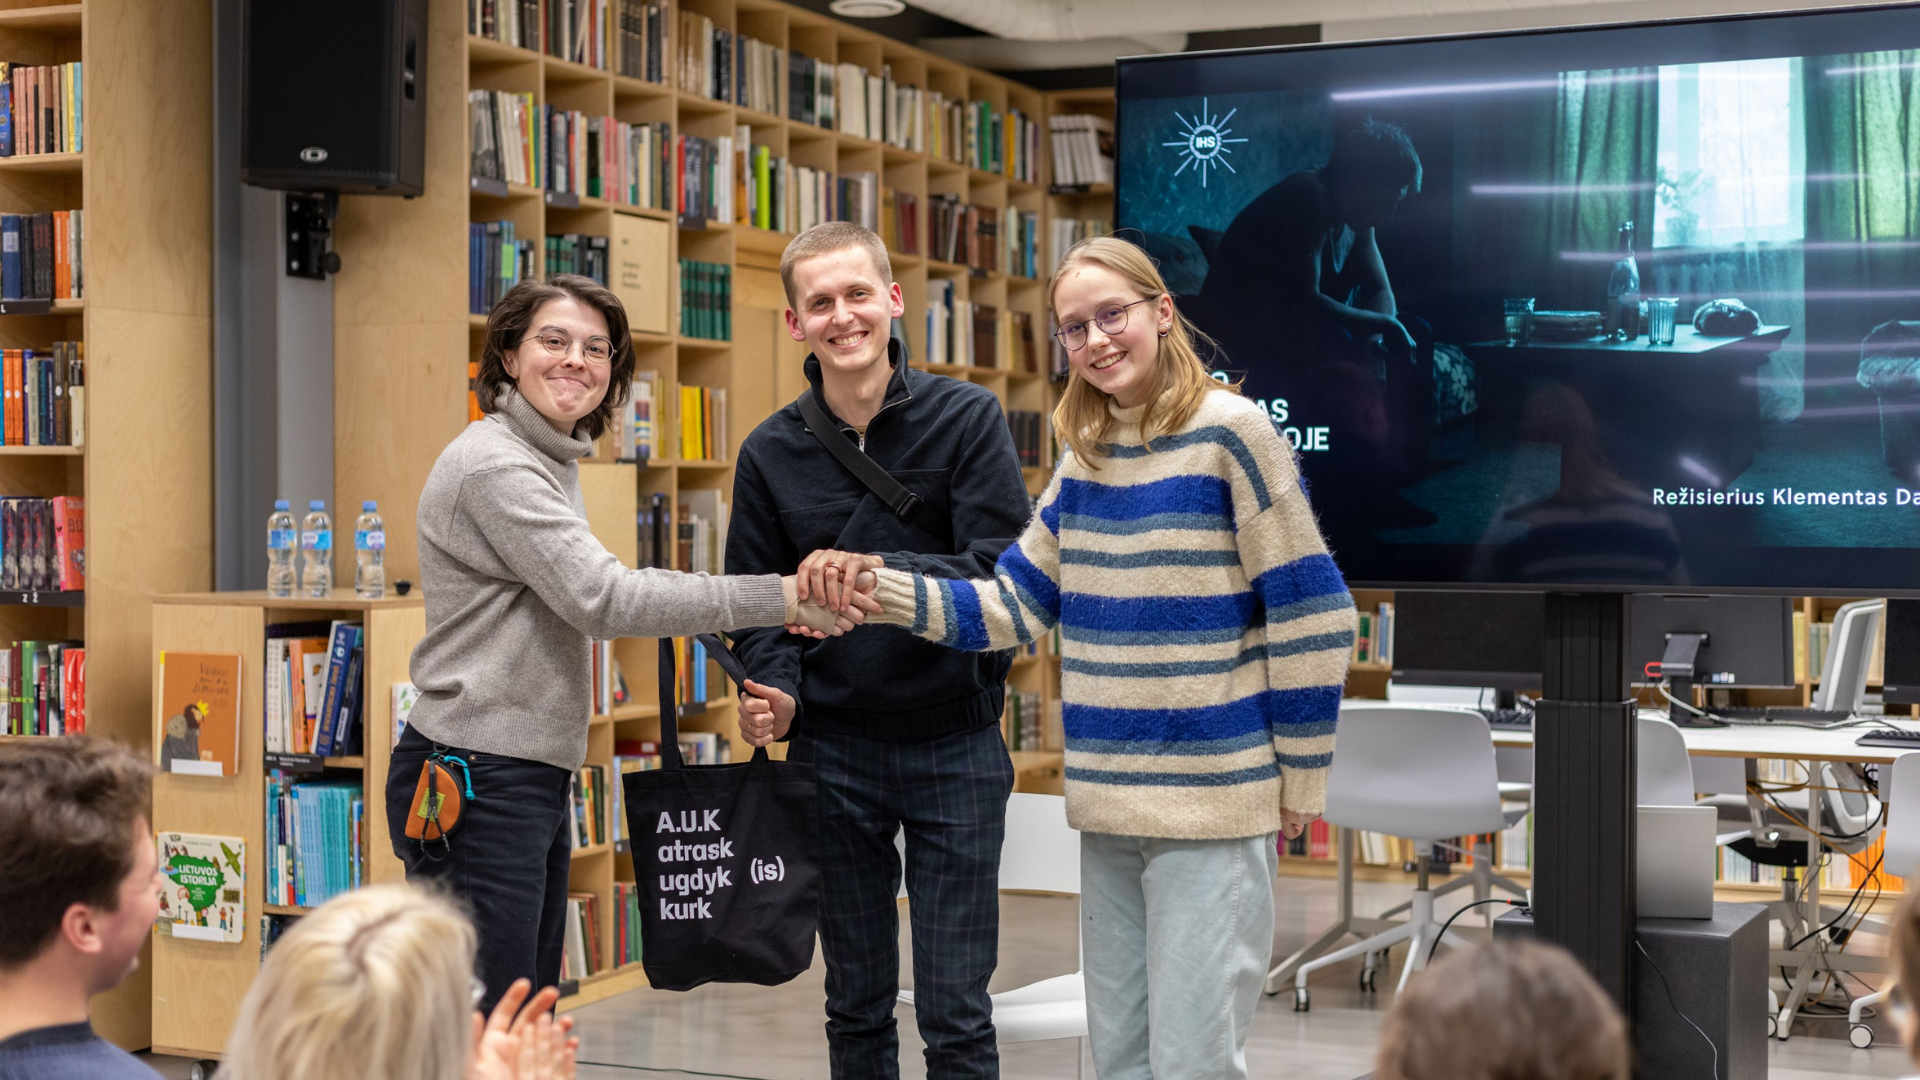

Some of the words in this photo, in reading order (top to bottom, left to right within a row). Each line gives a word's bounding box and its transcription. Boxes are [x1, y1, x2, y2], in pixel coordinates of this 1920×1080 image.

[1196, 136, 1216, 149] IHS
[1653, 487, 1765, 506] Režisierius
[1773, 487, 1888, 506] Klementas
[656, 809, 721, 833] A.U.K
[658, 837, 734, 862] atrask
[178, 864, 218, 876] LIETUVOS
[180, 874, 218, 886] ISTORIJA
[659, 866, 732, 896] ugdyk
[750, 856, 785, 885] (is)
[660, 897, 713, 920] kurk
